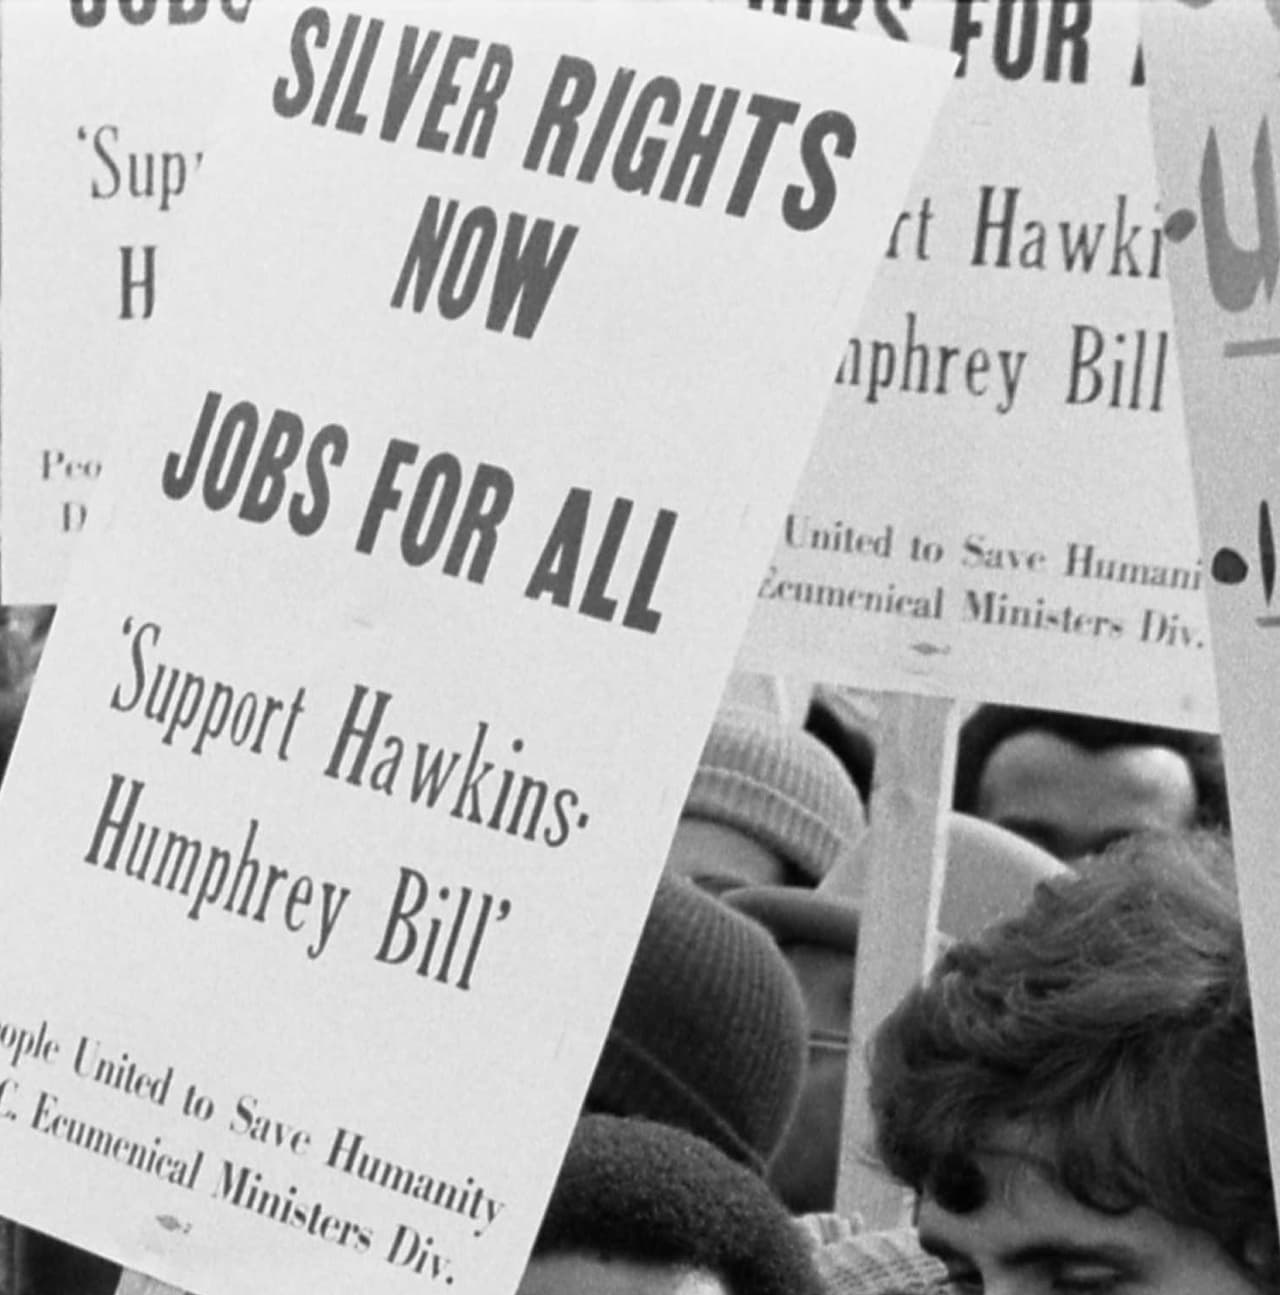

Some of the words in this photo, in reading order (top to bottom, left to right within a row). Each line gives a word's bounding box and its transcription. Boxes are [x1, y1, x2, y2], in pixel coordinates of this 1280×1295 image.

[950, 0, 1092, 84] FOR
[272, 6, 513, 159] SILVER
[522, 54, 856, 232] RIGHTS
[390, 195, 579, 340] NOW
[970, 185, 1166, 279] Hawki
[1065, 324, 1169, 413] Bill
[41, 449, 101, 481] Peo
[162, 390, 349, 537] JOBS
[355, 438, 515, 585] FOR
[524, 487, 679, 635] ALL
[784, 513, 893, 559] United
[910, 534, 944, 566] to
[961, 533, 1048, 574] Save
[1065, 542, 1203, 592] Humani
[962, 588, 1124, 641] Ministers
[1140, 608, 1205, 650] Div.
[84, 773, 351, 960] Humphrey
[30, 1090, 204, 1191] Ecumenical
[211, 1160, 373, 1255] Ministers
[386, 1224, 455, 1286] Div.
[73, 1036, 174, 1107] United
[182, 1082, 215, 1124] to
[229, 1094, 312, 1157] Save
[325, 1126, 507, 1237] Humanity
